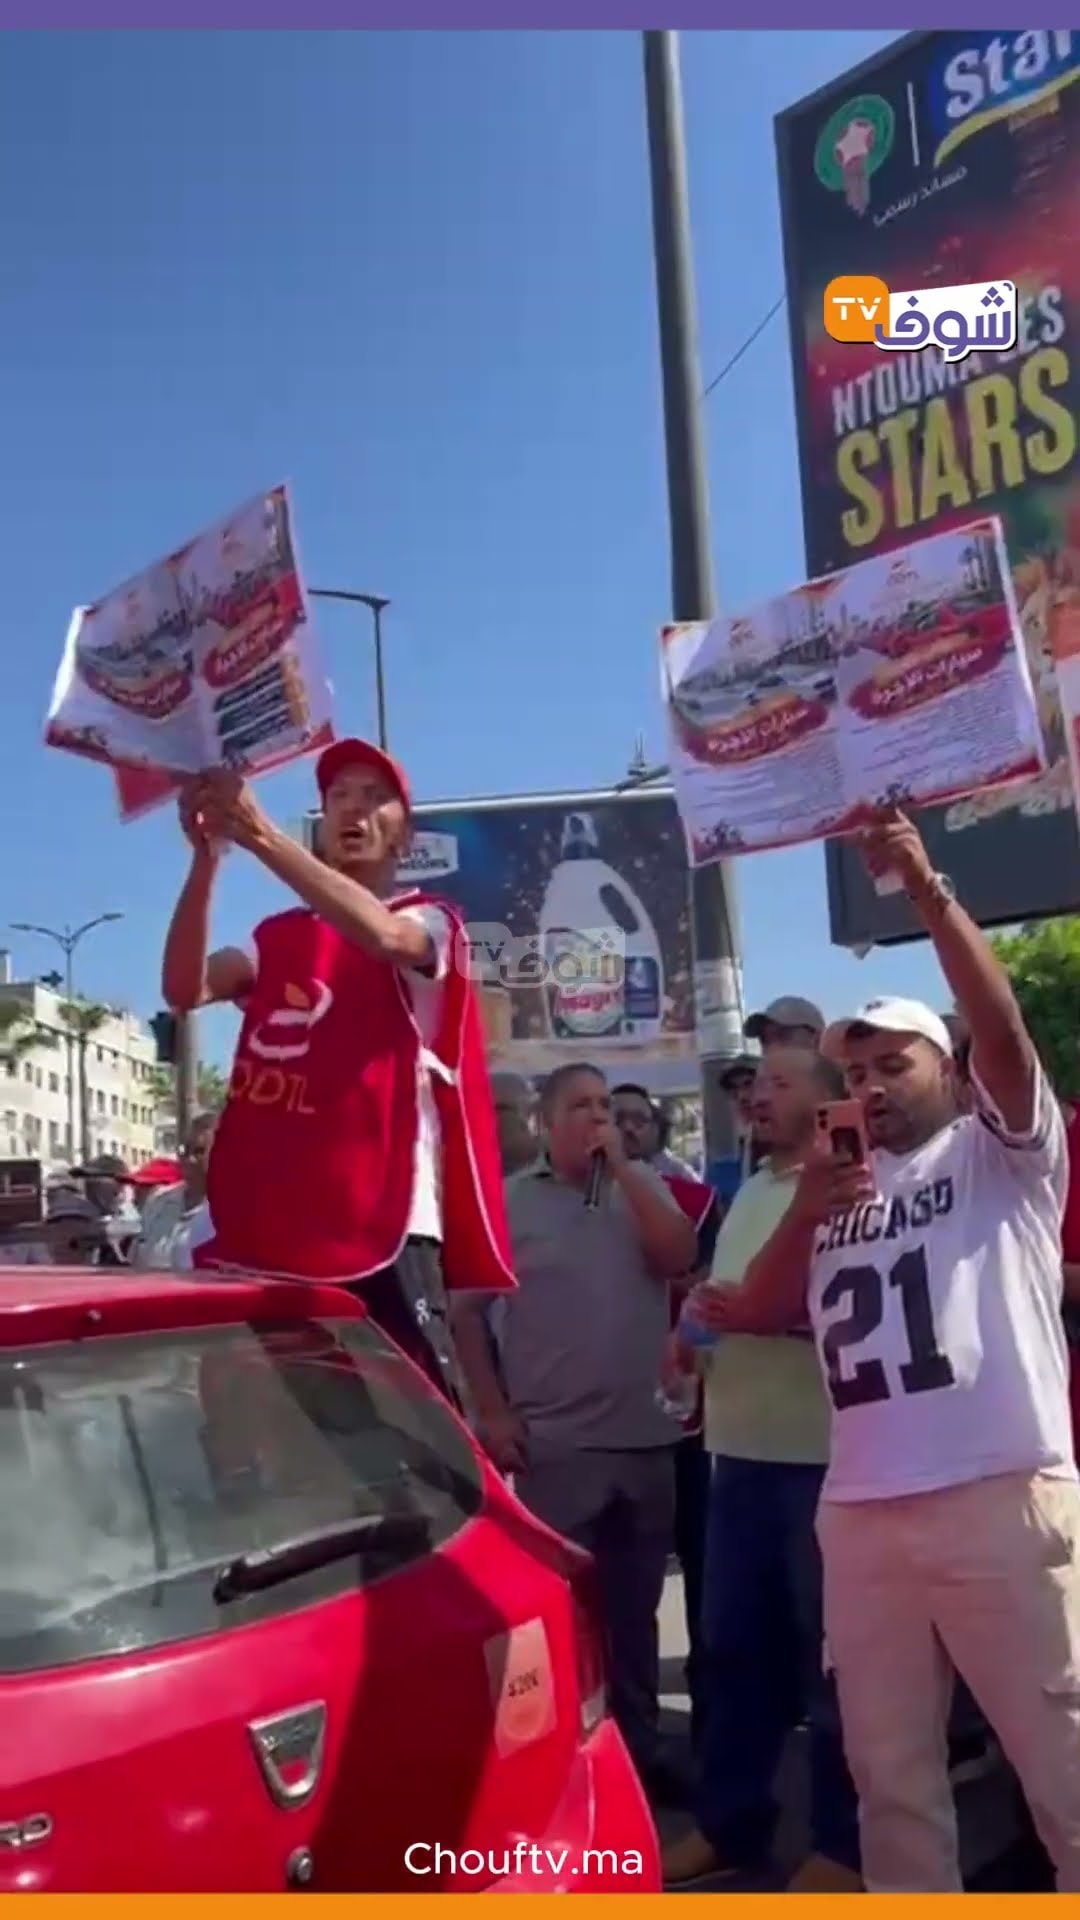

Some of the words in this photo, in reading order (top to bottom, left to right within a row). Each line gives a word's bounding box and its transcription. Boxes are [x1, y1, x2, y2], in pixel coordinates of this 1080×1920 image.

[873, 191, 918, 228] رسمي
[836, 346, 1076, 547] STARS
[815, 1176, 954, 1254] HICAGO
[821, 1243, 956, 1412] 21
